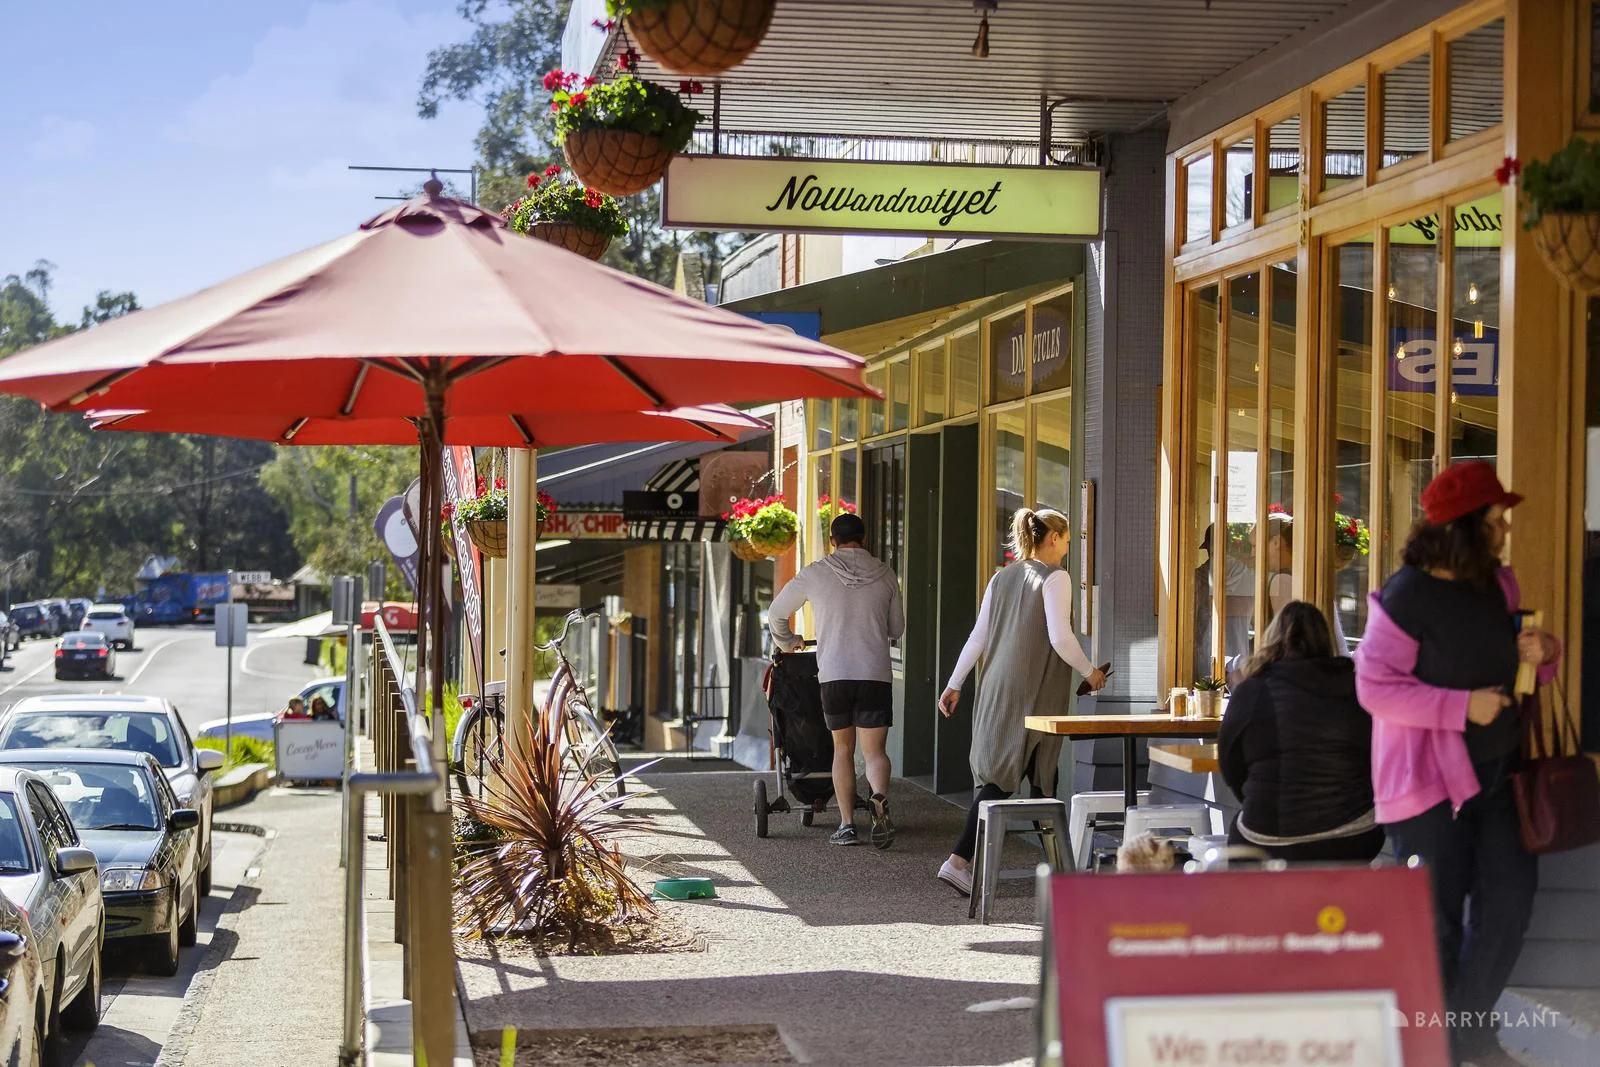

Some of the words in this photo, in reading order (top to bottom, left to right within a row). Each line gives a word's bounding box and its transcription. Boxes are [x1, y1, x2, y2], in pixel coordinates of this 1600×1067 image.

[766, 175, 1002, 227] Nowandnotyet
[1032, 326, 1061, 365] CYCLES
[543, 514, 567, 533] SH
[584, 514, 628, 533] CHIPS
[1148, 1033, 1206, 1064] We
[1219, 1034, 1288, 1064] rate
[1298, 1038, 1356, 1064] our
